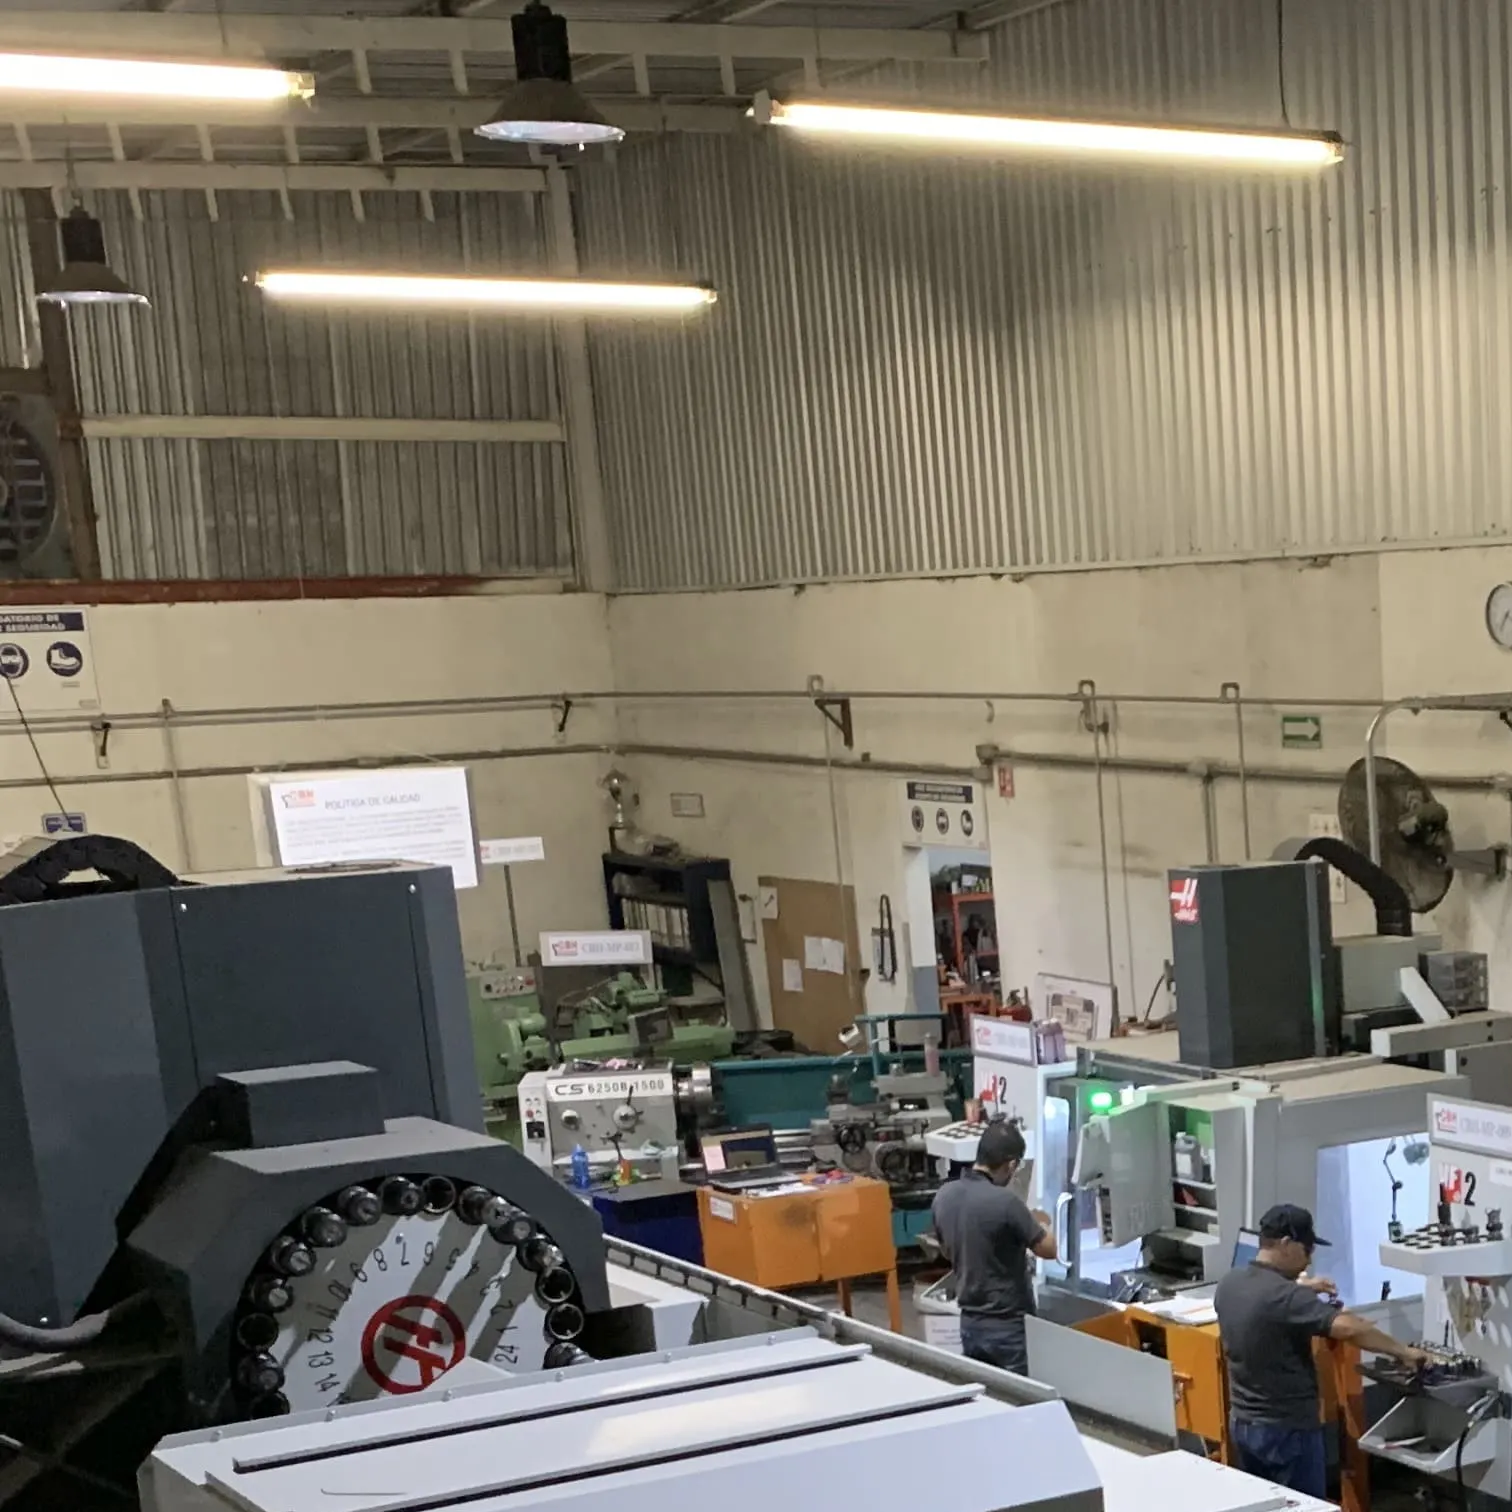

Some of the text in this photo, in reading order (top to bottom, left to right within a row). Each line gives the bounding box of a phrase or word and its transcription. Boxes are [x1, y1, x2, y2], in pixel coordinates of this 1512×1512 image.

[554, 1083, 584, 1096] CS
[373, 1248, 388, 1272] 8
[307, 1327, 335, 1344] 12
[307, 1350, 335, 1369] 13
[494, 1344, 520, 1365] 24
